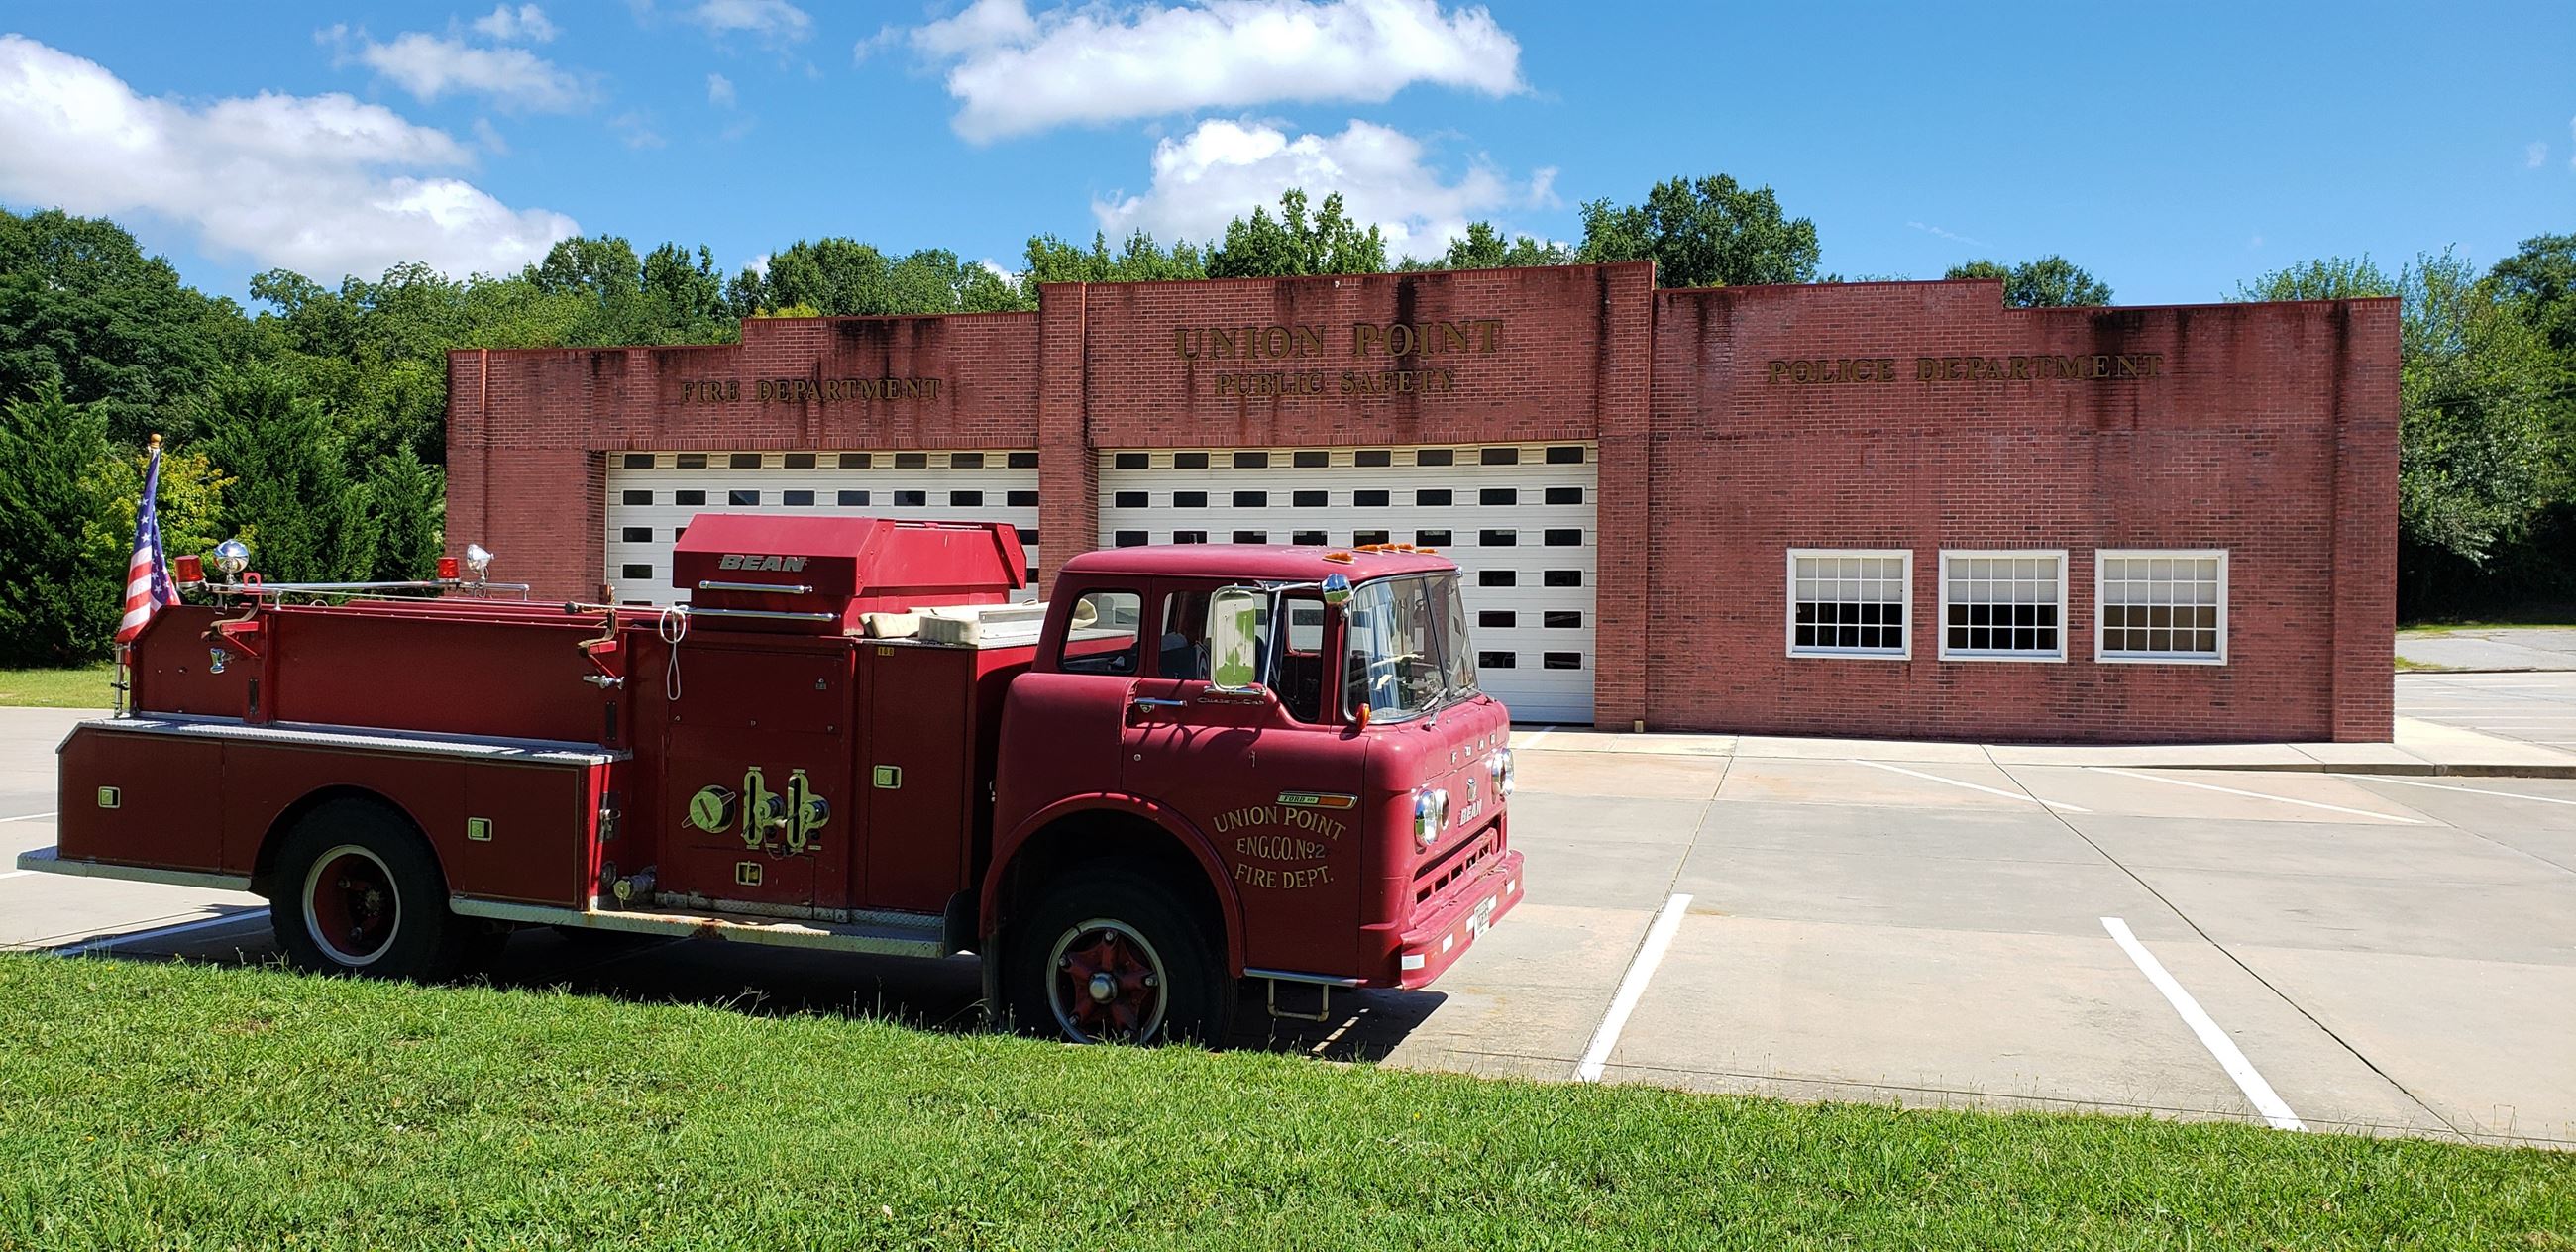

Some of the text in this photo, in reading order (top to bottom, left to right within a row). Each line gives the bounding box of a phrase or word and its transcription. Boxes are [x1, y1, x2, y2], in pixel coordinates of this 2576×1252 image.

[1174, 319, 1503, 361] UNION POINT
[1215, 369, 1457, 396] PUBLIC SAFETY
[1768, 353, 2164, 384] POLICE DEPARTMENT
[681, 377, 942, 402] FIRE DEPARTMENT
[719, 555, 808, 572] BEAN
[1213, 806, 1347, 841] UNION POINT
[1458, 798, 1483, 827] BEAN
[1235, 863, 1335, 889] FIRE DEPT.
